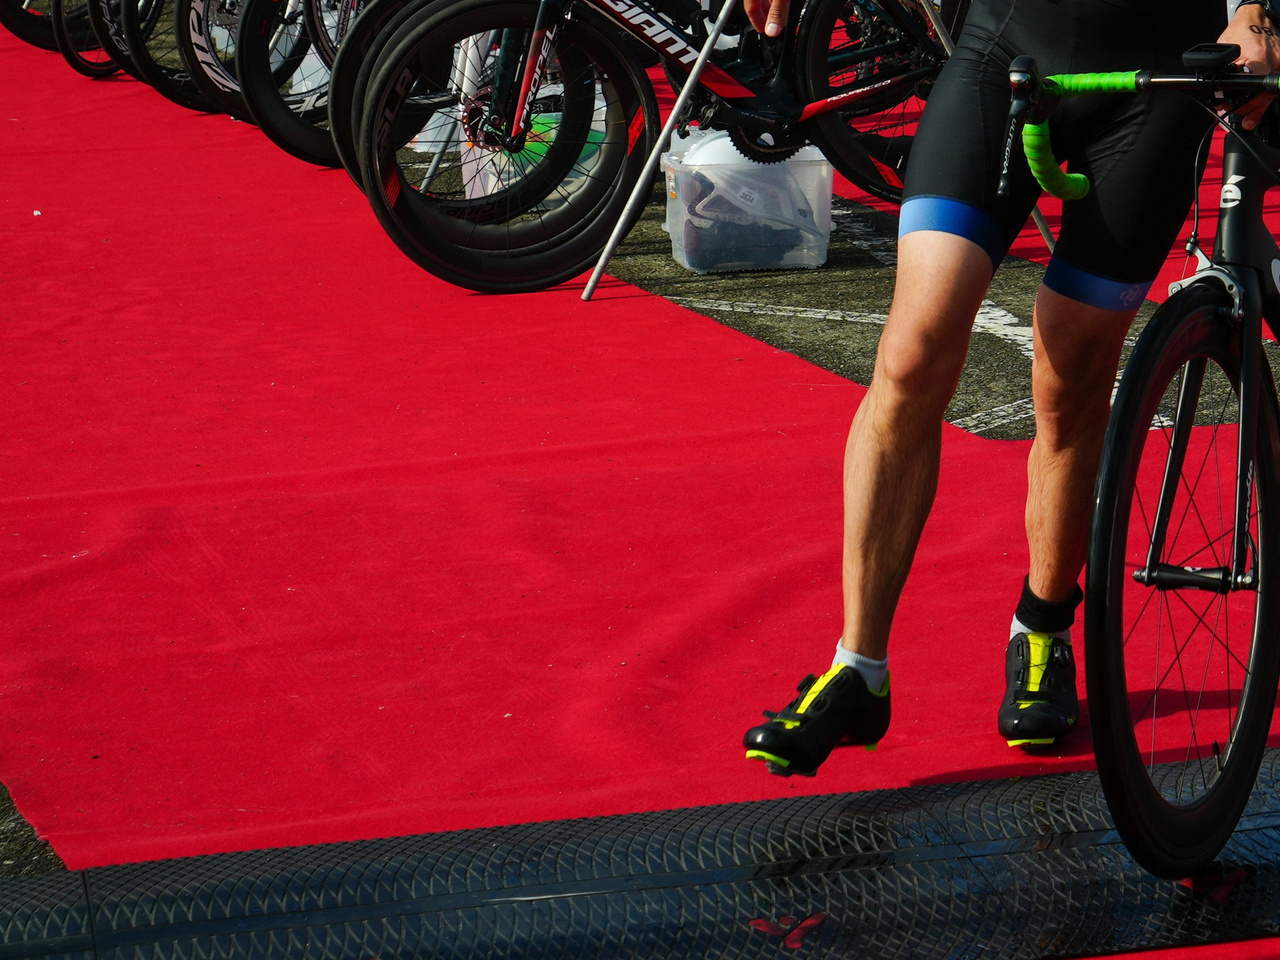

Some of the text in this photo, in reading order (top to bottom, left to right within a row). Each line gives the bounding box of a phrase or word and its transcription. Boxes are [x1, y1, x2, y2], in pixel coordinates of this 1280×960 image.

[519, 24, 557, 130] PROPEL
[827, 79, 891, 102] ADVANCED
[1002, 118, 1017, 175] ULTEGRA
[1219, 174, 1246, 208] é
